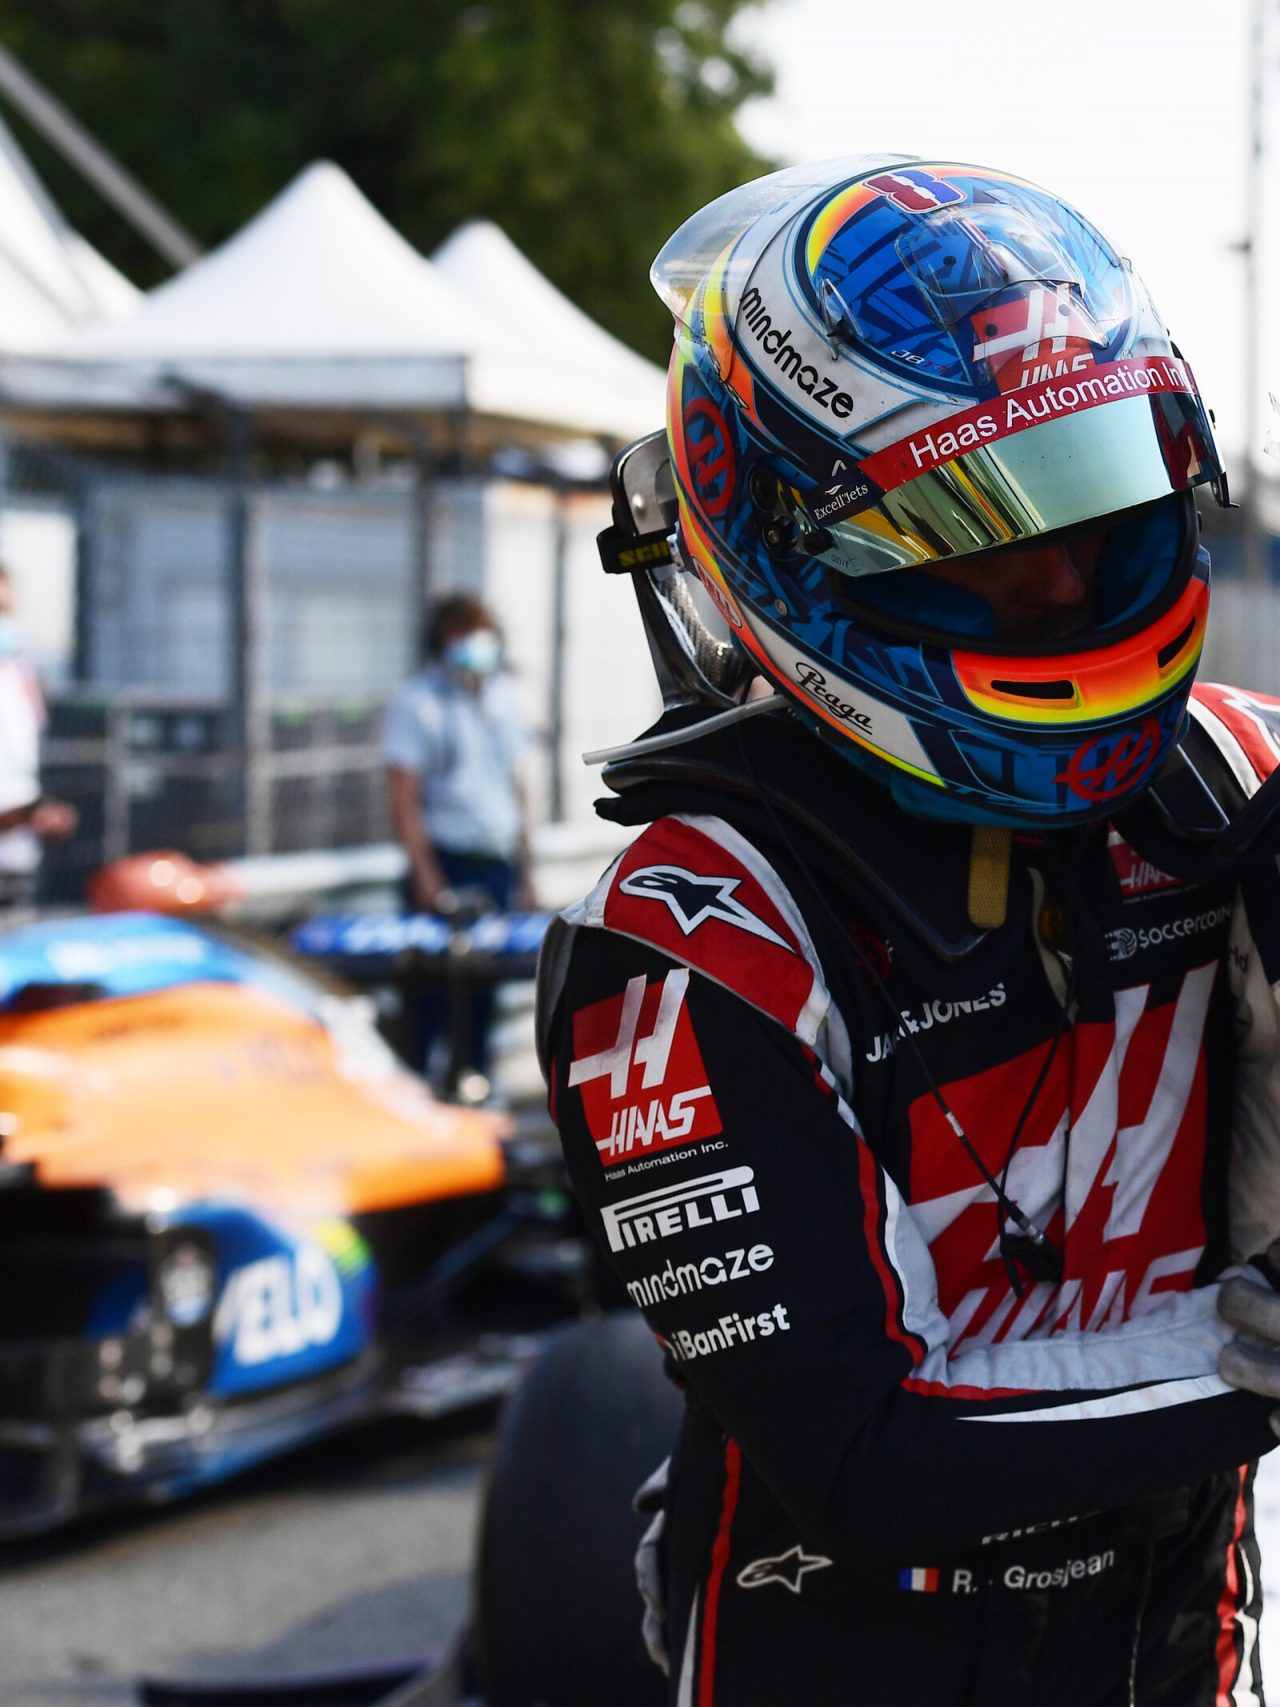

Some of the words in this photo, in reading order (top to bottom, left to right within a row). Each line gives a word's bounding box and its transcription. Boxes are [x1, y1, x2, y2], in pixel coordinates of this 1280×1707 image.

[739, 287, 854, 419] mindmaze
[909, 415, 998, 468] Haas
[1006, 364, 1165, 428] Automation
[795, 661, 873, 736] Praga
[595, 1085, 712, 1157] HAAS
[604, 1170, 626, 1182] Haas
[627, 1147, 698, 1175] Automation
[700, 1140, 729, 1154] Inc.
[600, 1165, 761, 1253] PIRELLI
[627, 1243, 775, 1308] mindmaze
[952, 1568, 978, 1594] R.
[1003, 1549, 1115, 1588] Grosjean
